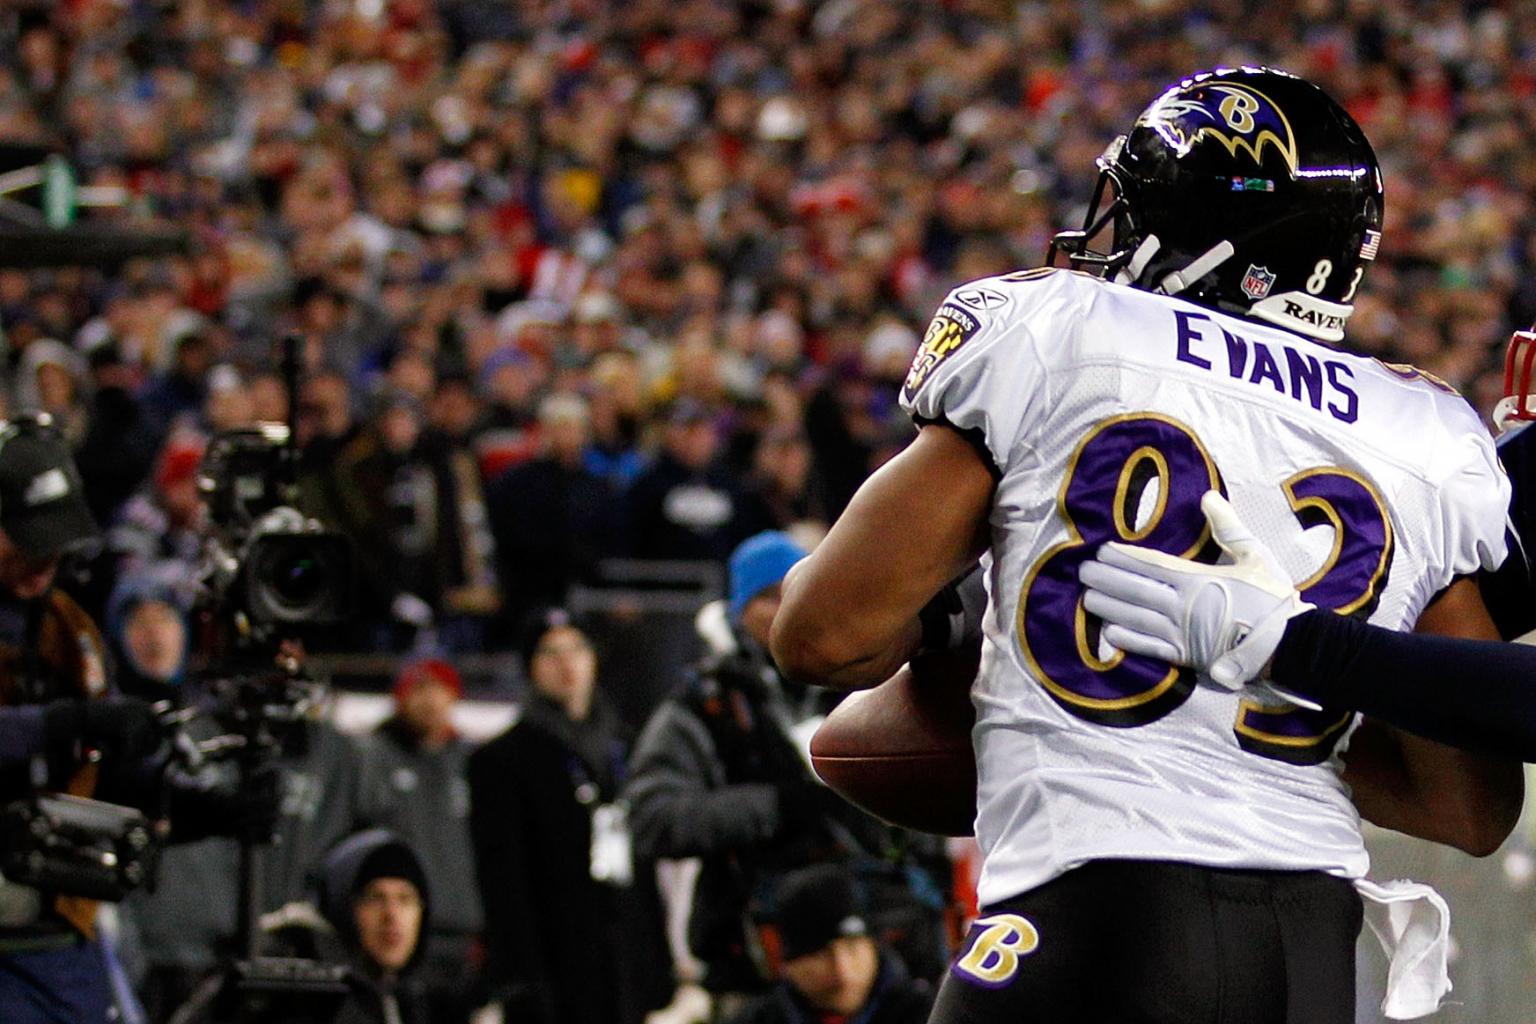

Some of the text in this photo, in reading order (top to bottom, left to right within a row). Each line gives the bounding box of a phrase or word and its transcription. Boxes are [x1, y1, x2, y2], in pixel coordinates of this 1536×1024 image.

[1210, 86, 1260, 134] B
[1173, 309, 1359, 425] EVANS
[1016, 410, 1396, 766] 83
[955, 910, 1041, 986] B
